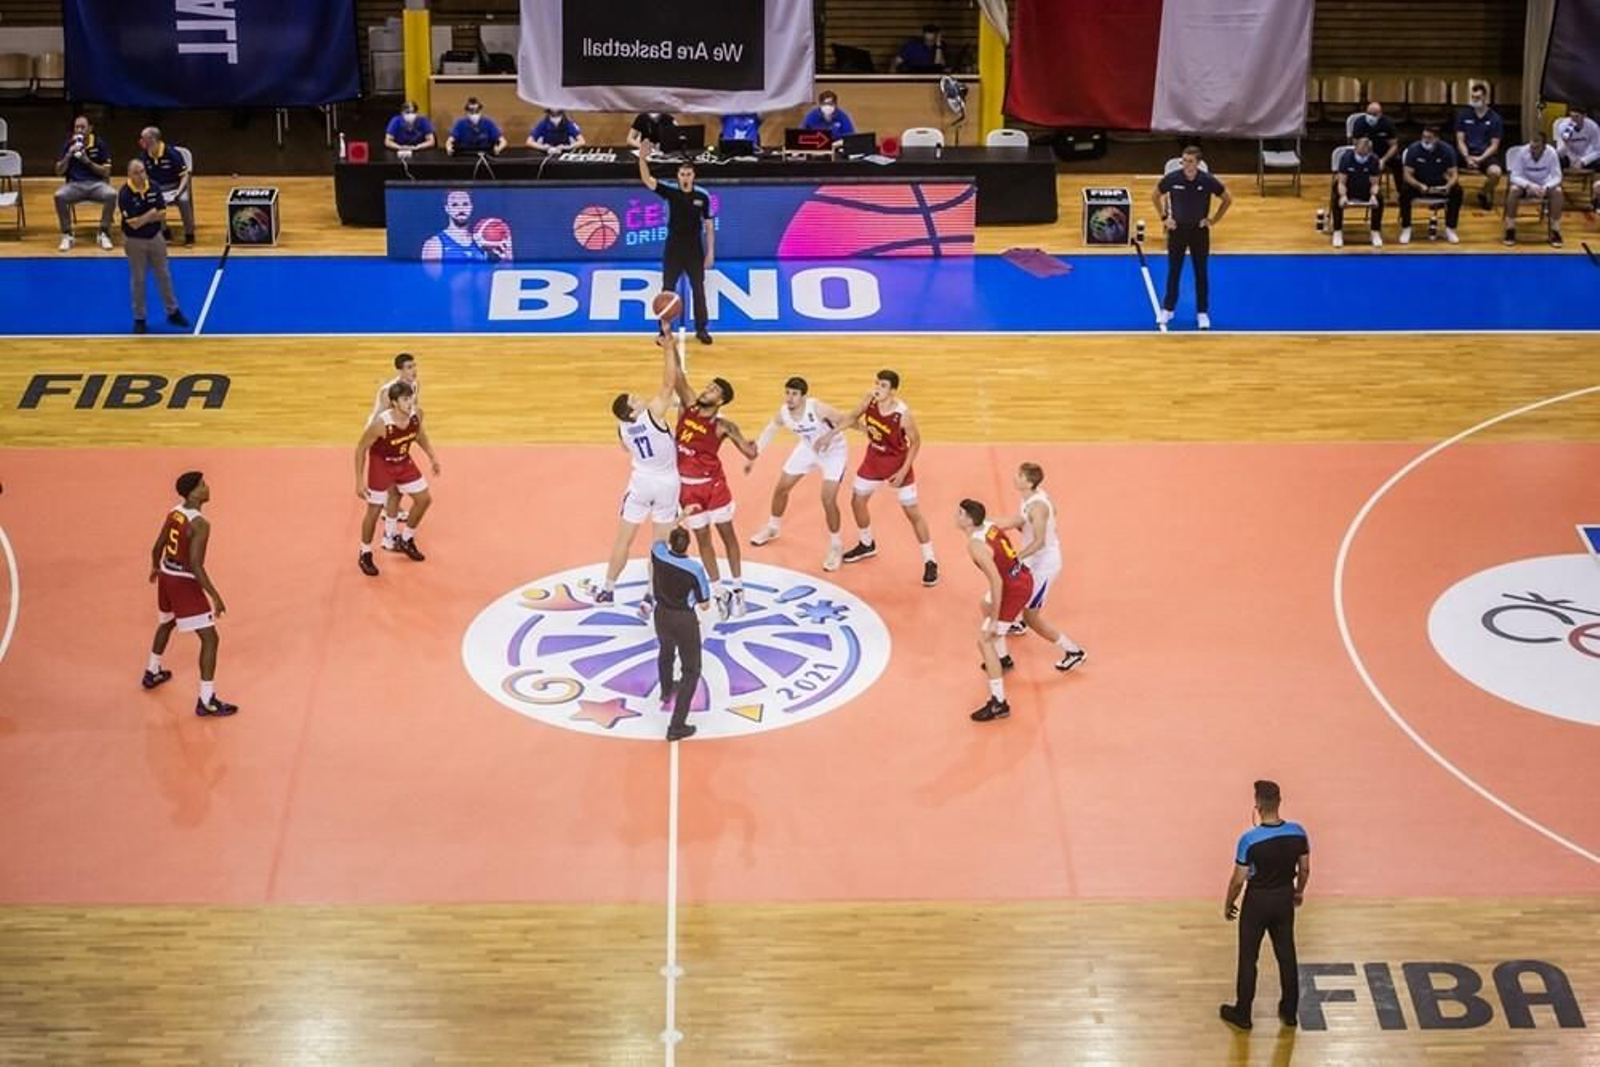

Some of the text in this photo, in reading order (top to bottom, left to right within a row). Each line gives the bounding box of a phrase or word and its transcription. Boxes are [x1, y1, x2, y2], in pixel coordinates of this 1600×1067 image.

[488, 267, 881, 320] BRNO
[17, 373, 231, 409] FIBA
[633, 435, 654, 459] 17
[167, 528, 180, 555] 5
[776, 663, 838, 700] 2021
[1297, 959, 1587, 1031] FIBA
